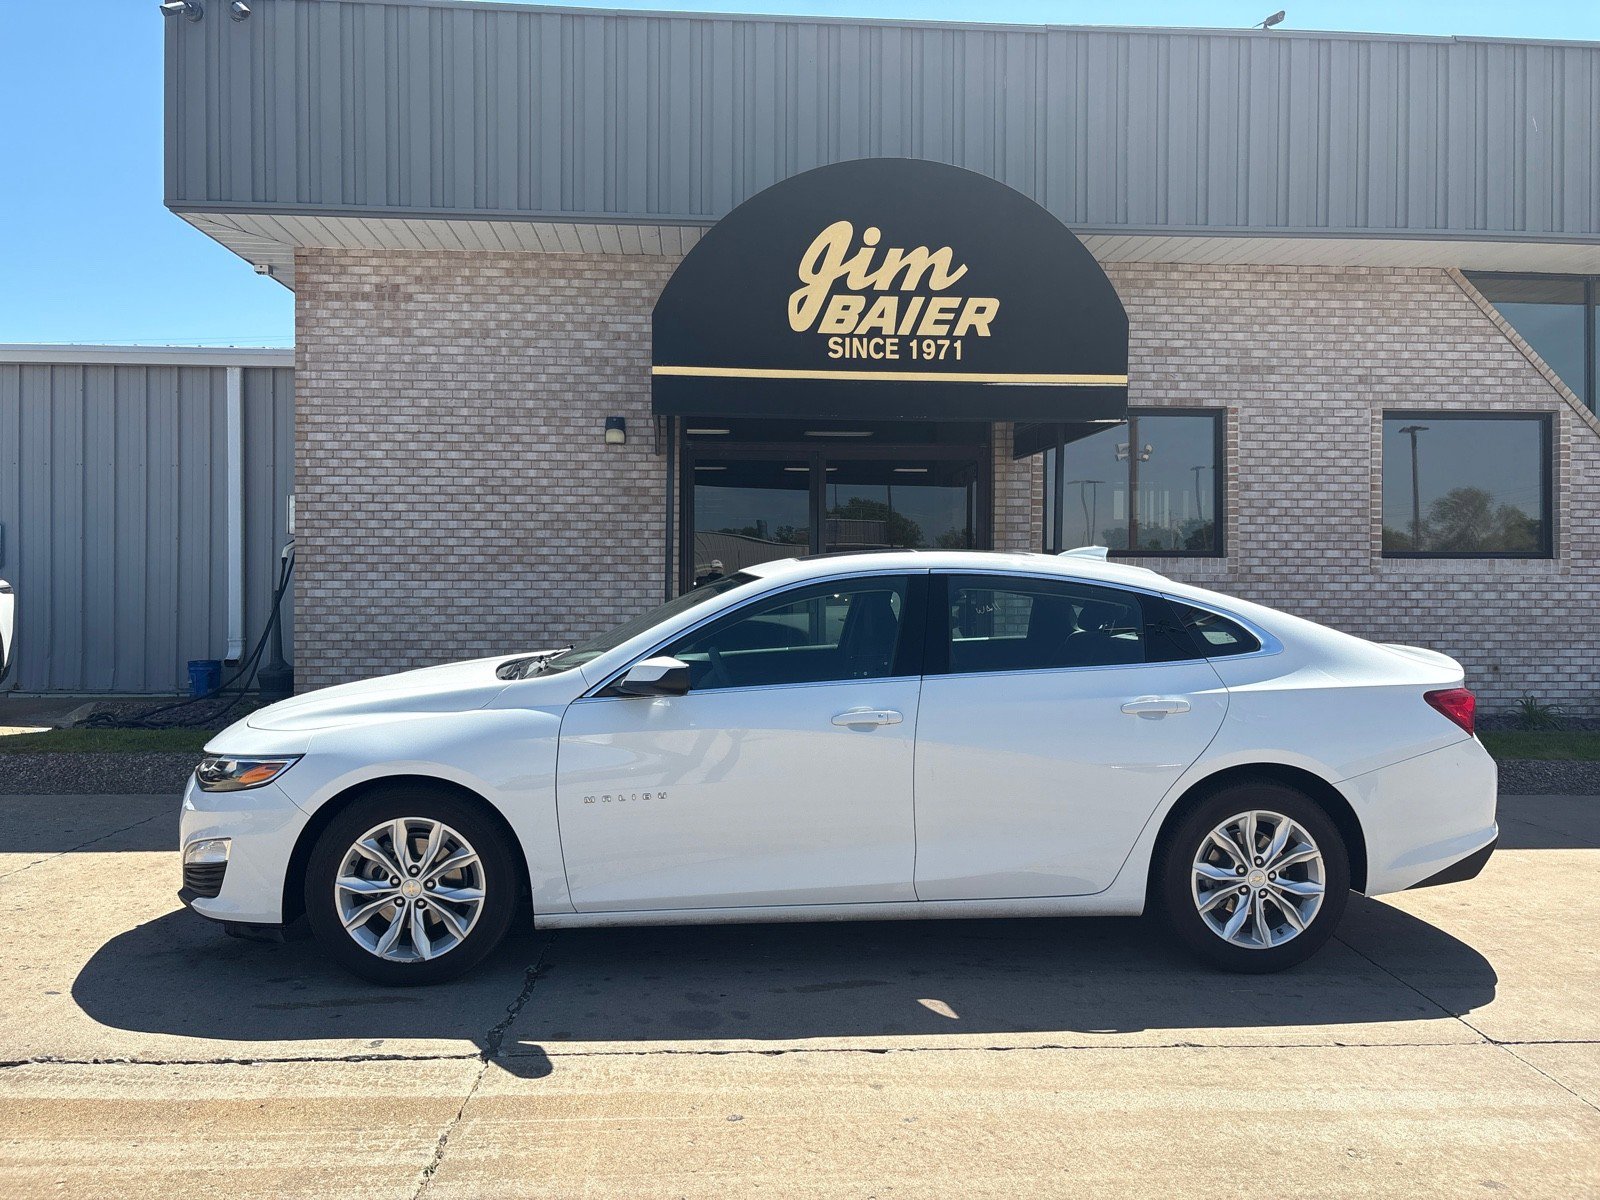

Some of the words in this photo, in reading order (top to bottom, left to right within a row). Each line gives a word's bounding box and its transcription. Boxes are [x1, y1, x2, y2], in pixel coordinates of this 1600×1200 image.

[787, 220, 969, 333] Jim
[817, 294, 1001, 337] BAIER
[827, 336, 900, 359] SINCE
[909, 339, 962, 361] 1971
[583, 791, 668, 804] MALIBU
